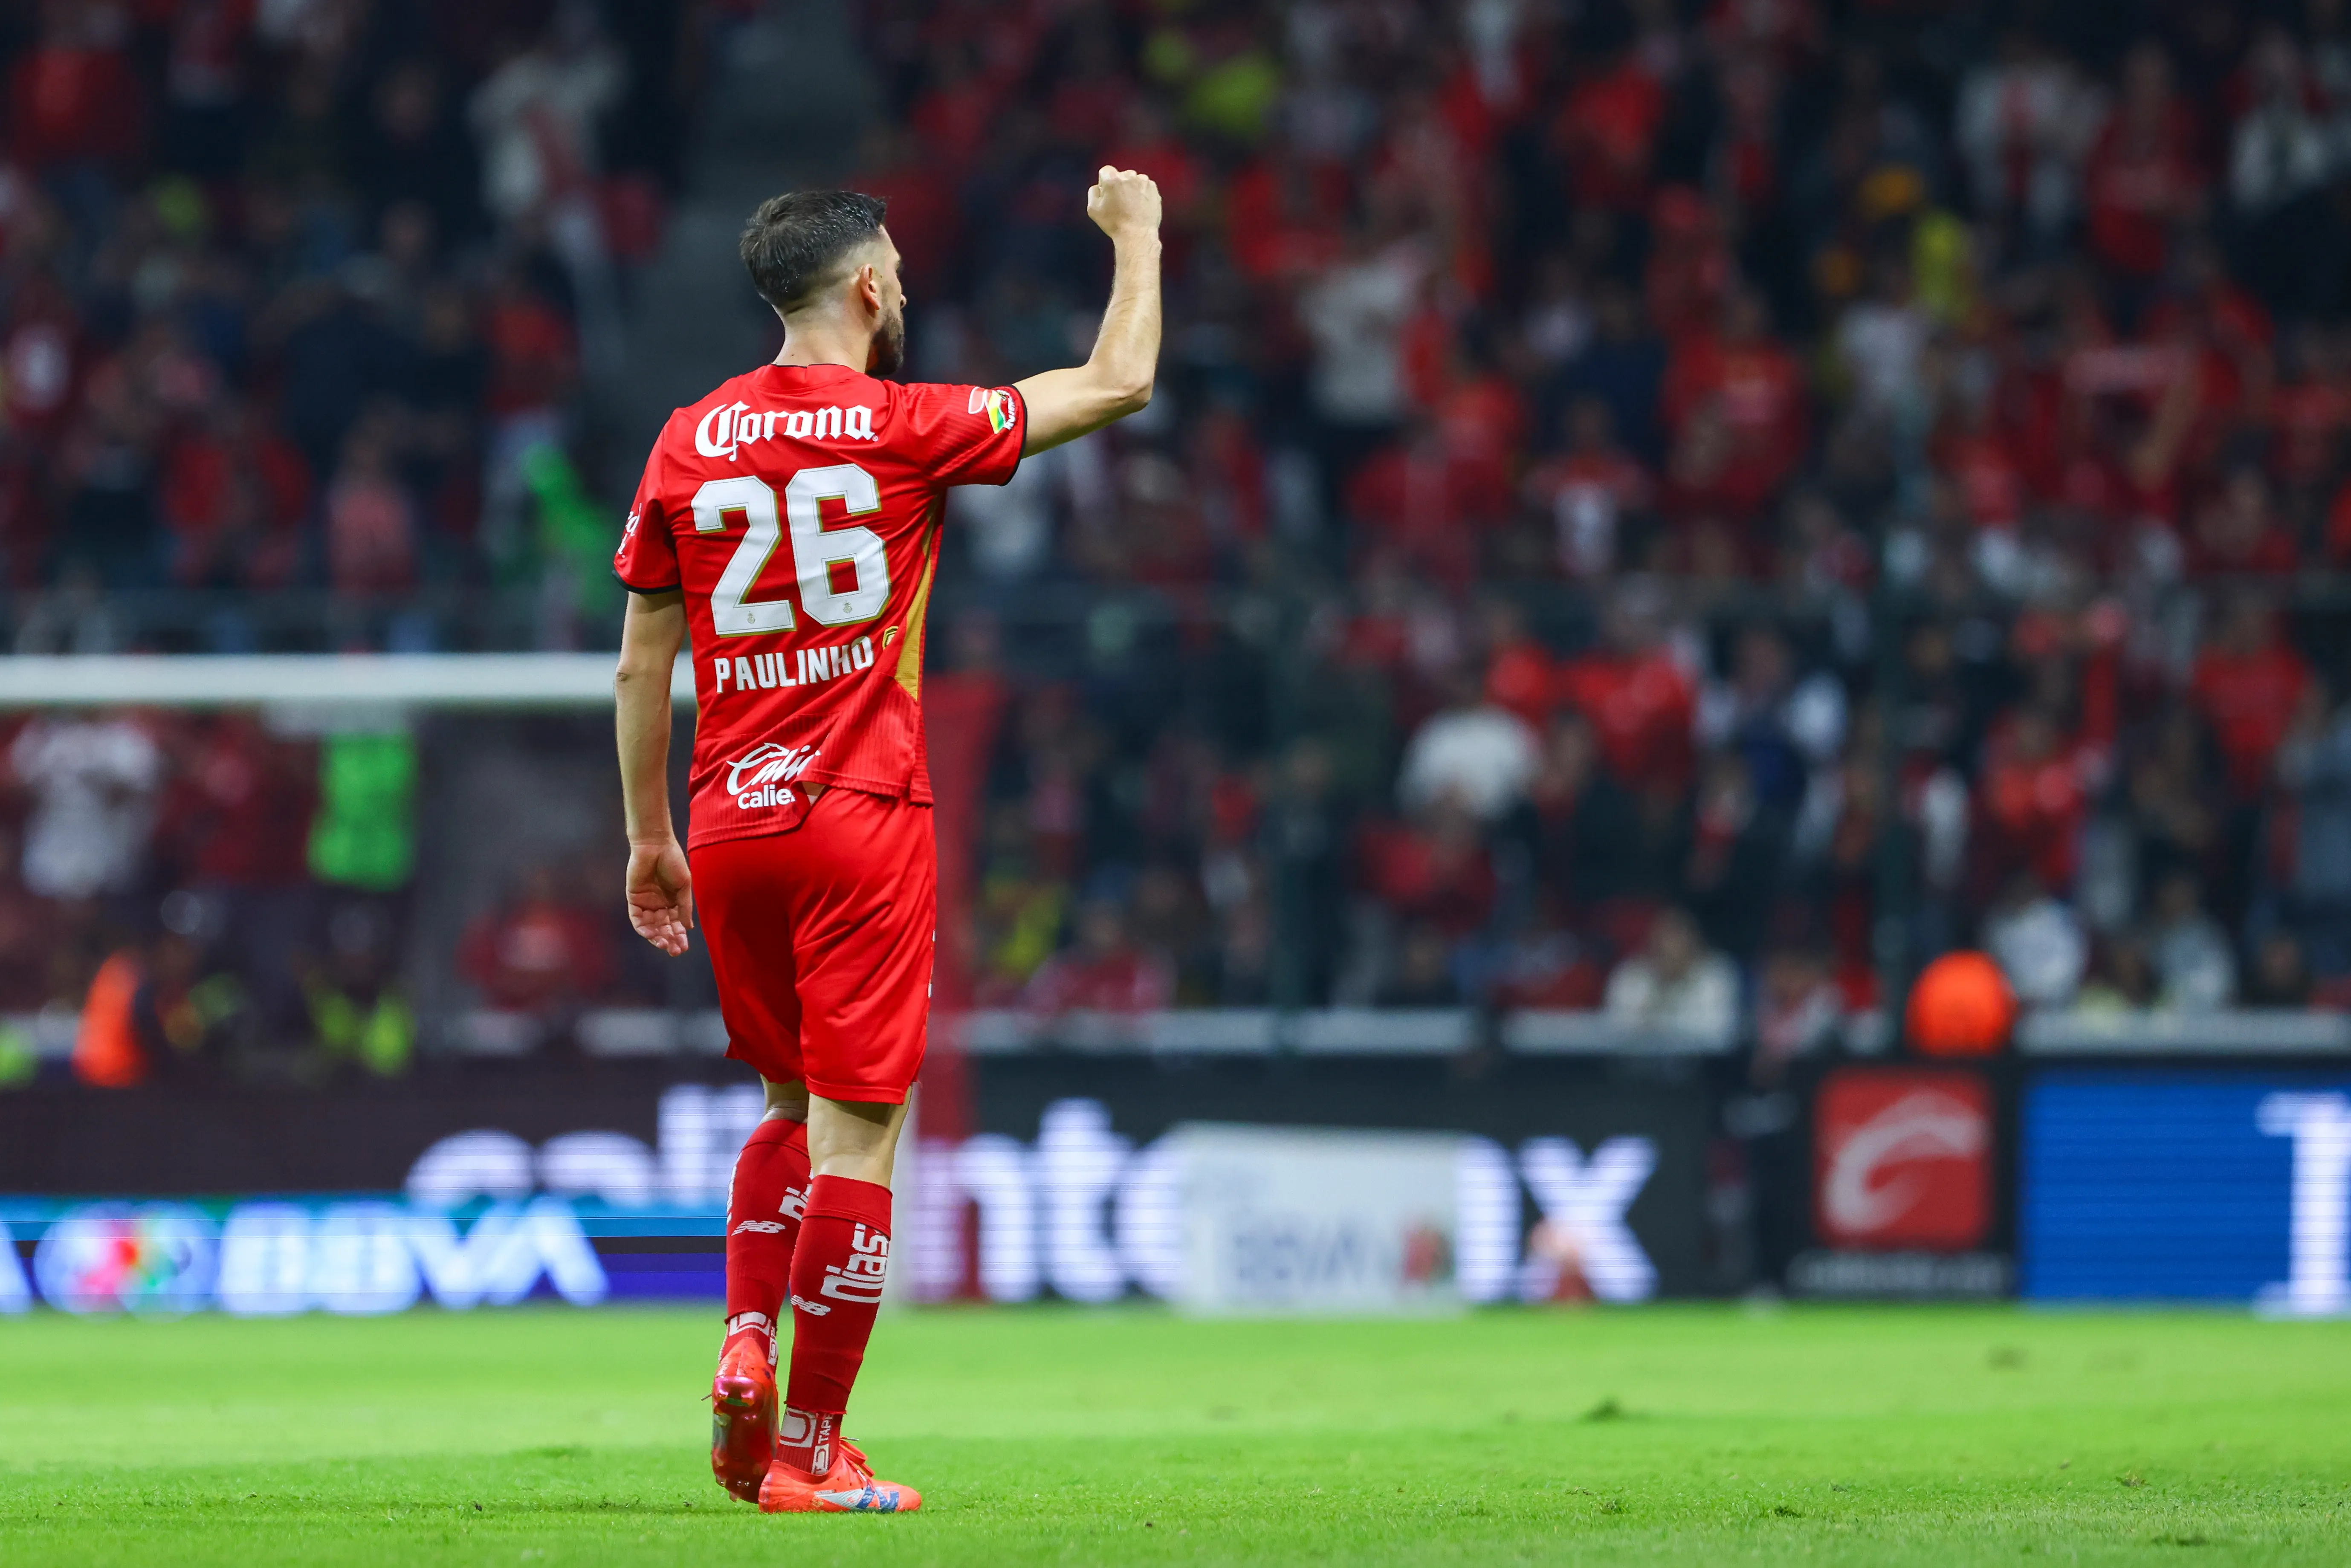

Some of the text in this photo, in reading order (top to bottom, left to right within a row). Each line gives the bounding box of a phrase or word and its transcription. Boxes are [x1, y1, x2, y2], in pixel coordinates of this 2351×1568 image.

[695, 400, 876, 462] Corona
[691, 463, 892, 637] 26
[715, 635, 874, 694] PAULINHO
